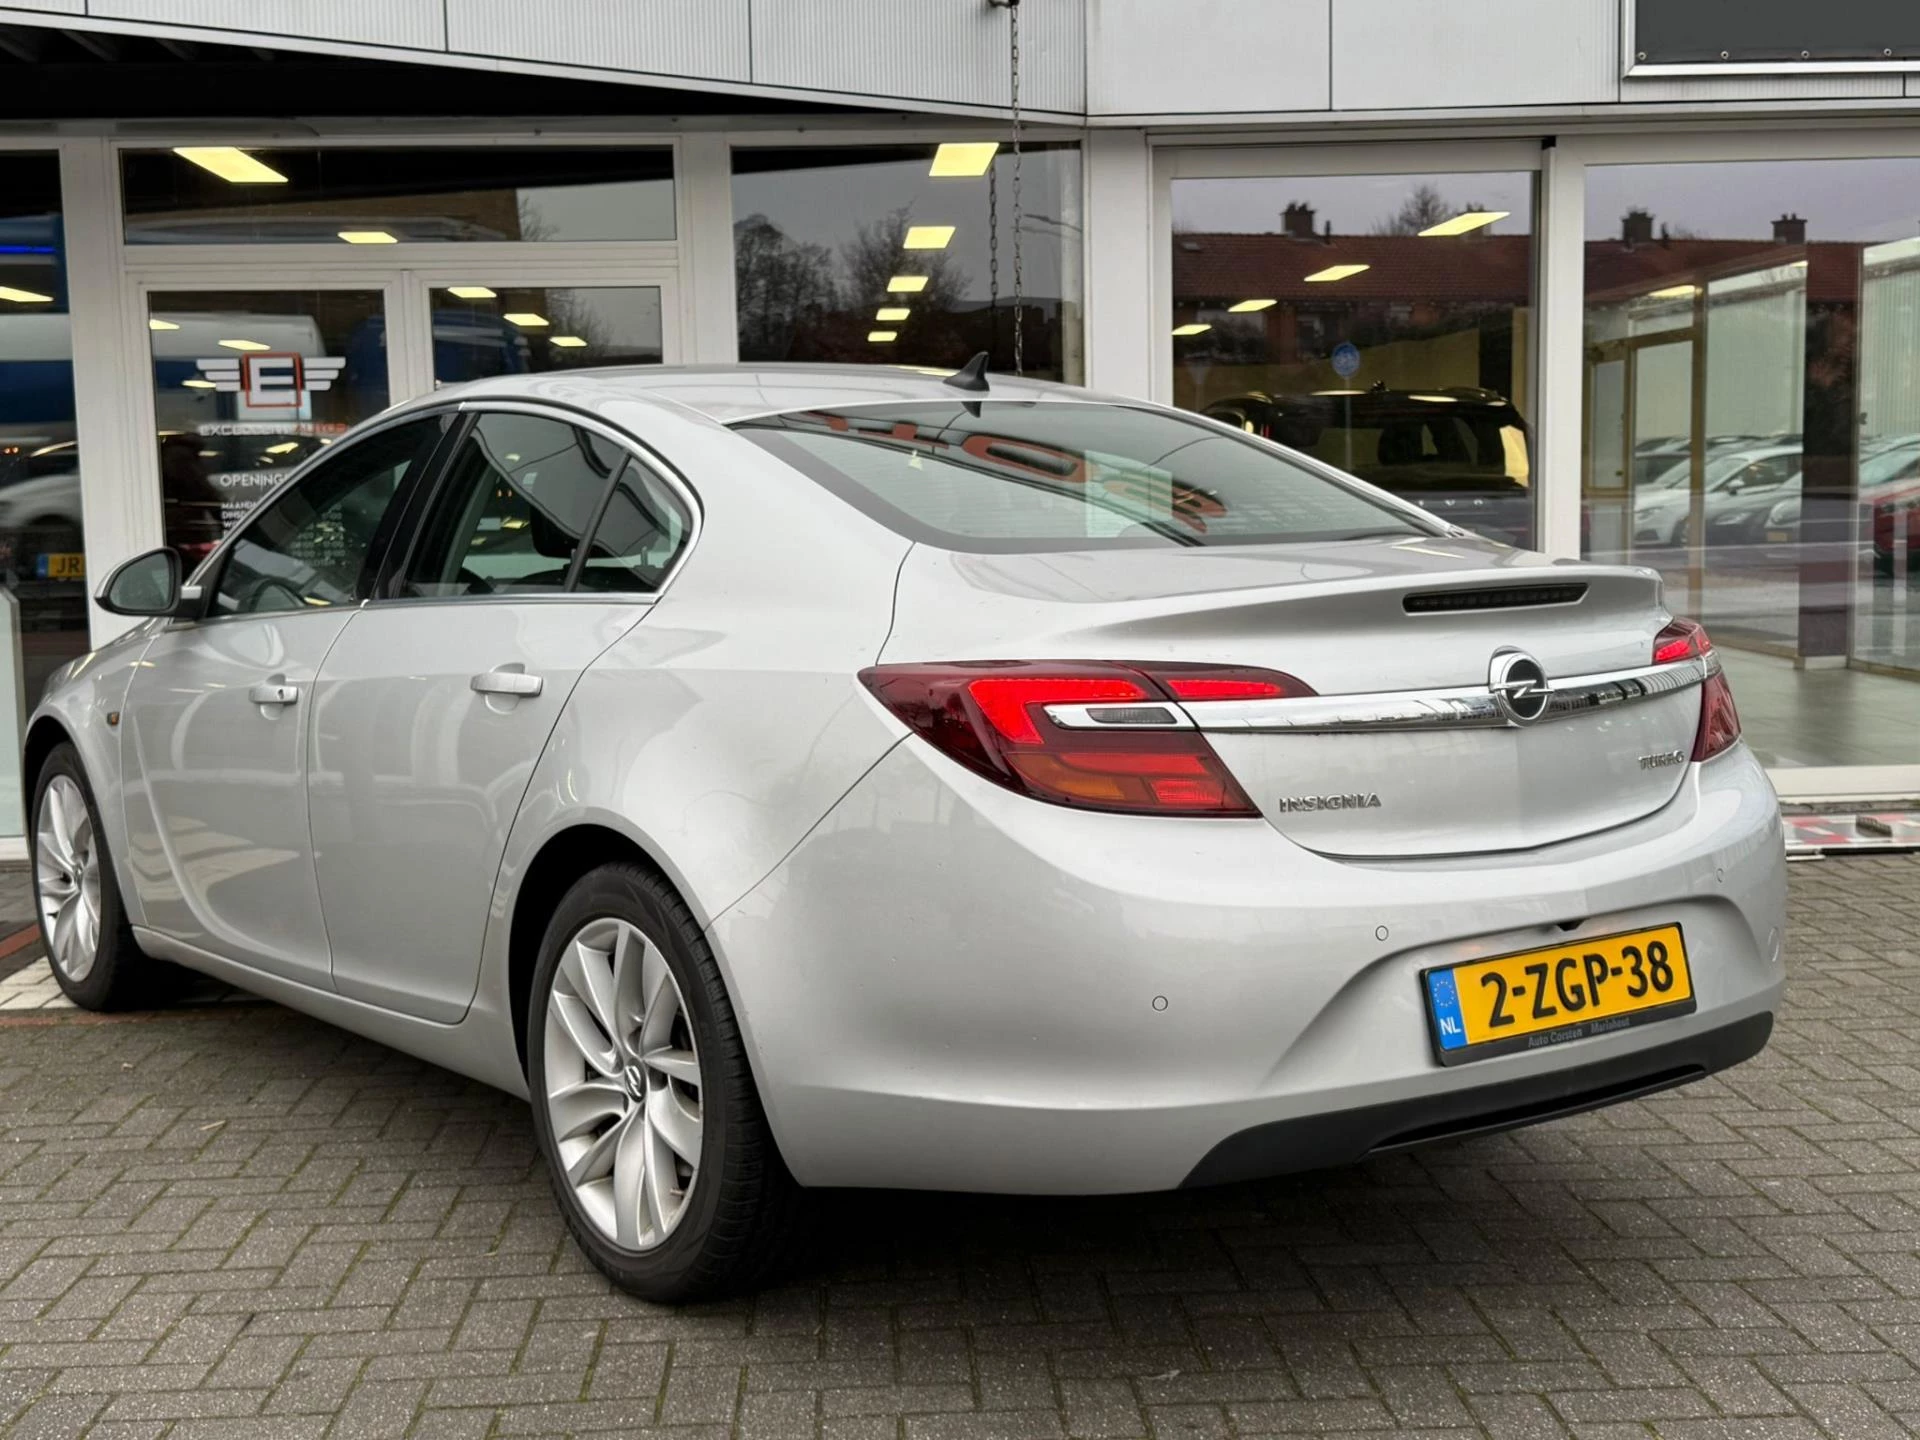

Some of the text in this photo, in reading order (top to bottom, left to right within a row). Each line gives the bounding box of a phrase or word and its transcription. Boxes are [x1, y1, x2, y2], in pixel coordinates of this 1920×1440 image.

[220, 474, 290, 487] OPENING
[57, 557, 84, 573] JR
[1638, 750, 1684, 769] TURBO
[1279, 793, 1382, 813] INSIGNIA
[1440, 940, 1674, 1035] NL 2-ZGP-38
[1528, 1035, 1549, 1048] Auto
